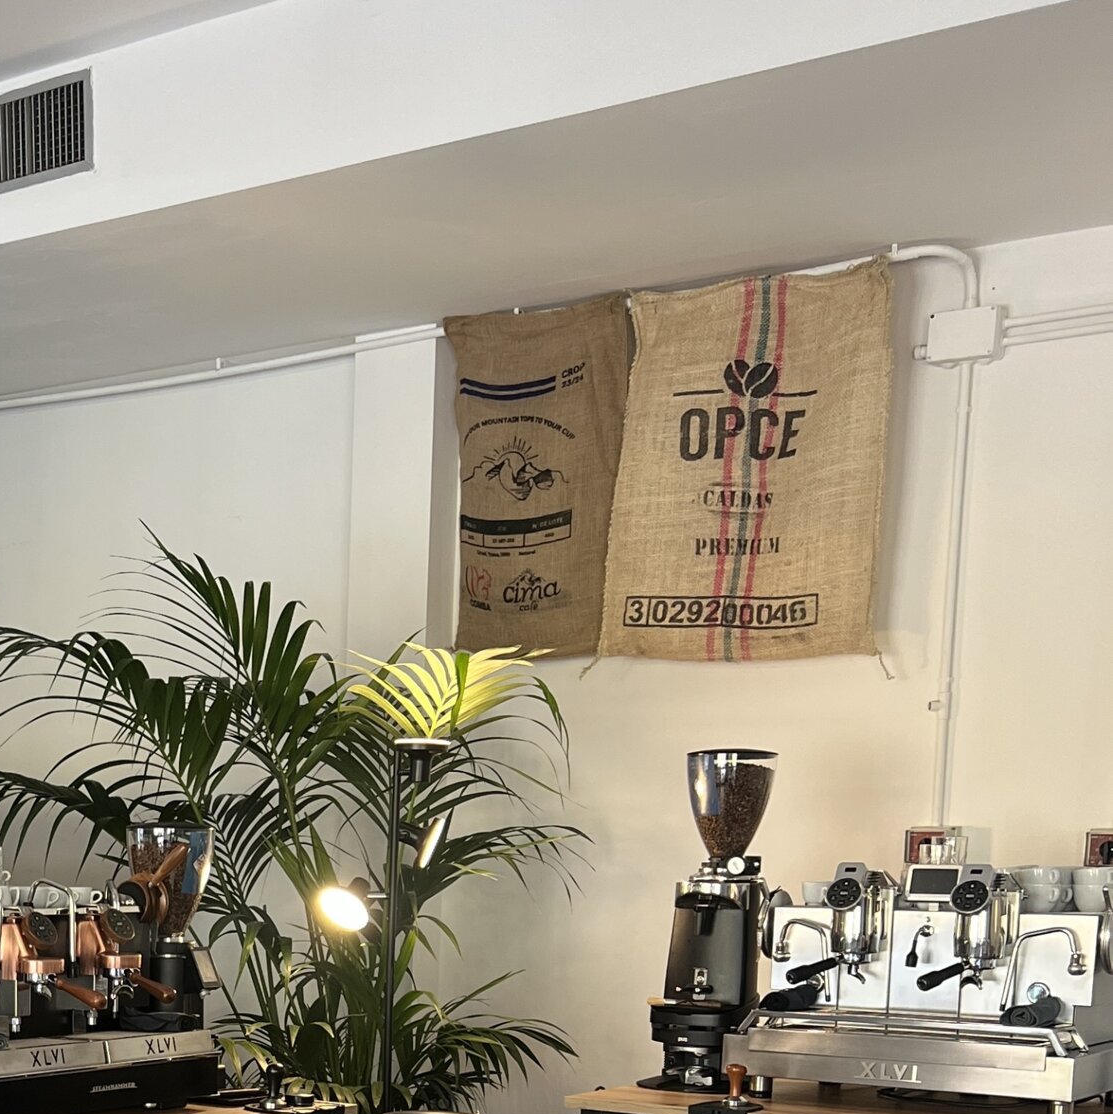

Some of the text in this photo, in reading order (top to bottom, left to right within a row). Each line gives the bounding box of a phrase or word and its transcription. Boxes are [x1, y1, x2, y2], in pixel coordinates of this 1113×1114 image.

[561, 362, 586, 379] CROP
[481, 416, 519, 427] MOUNTAIN
[543, 419, 562, 432] YOUR
[561, 427, 576, 440] CUP
[679, 406, 806, 461] OPCE
[702, 489, 774, 509] CALDAS
[695, 537, 781, 556] PREMIUM
[502, 581, 562, 604] cima
[145, 1036, 178, 1055] XLVI
[30, 1048, 66, 1067] XLVI
[859, 1061, 920, 1082] XLVI
